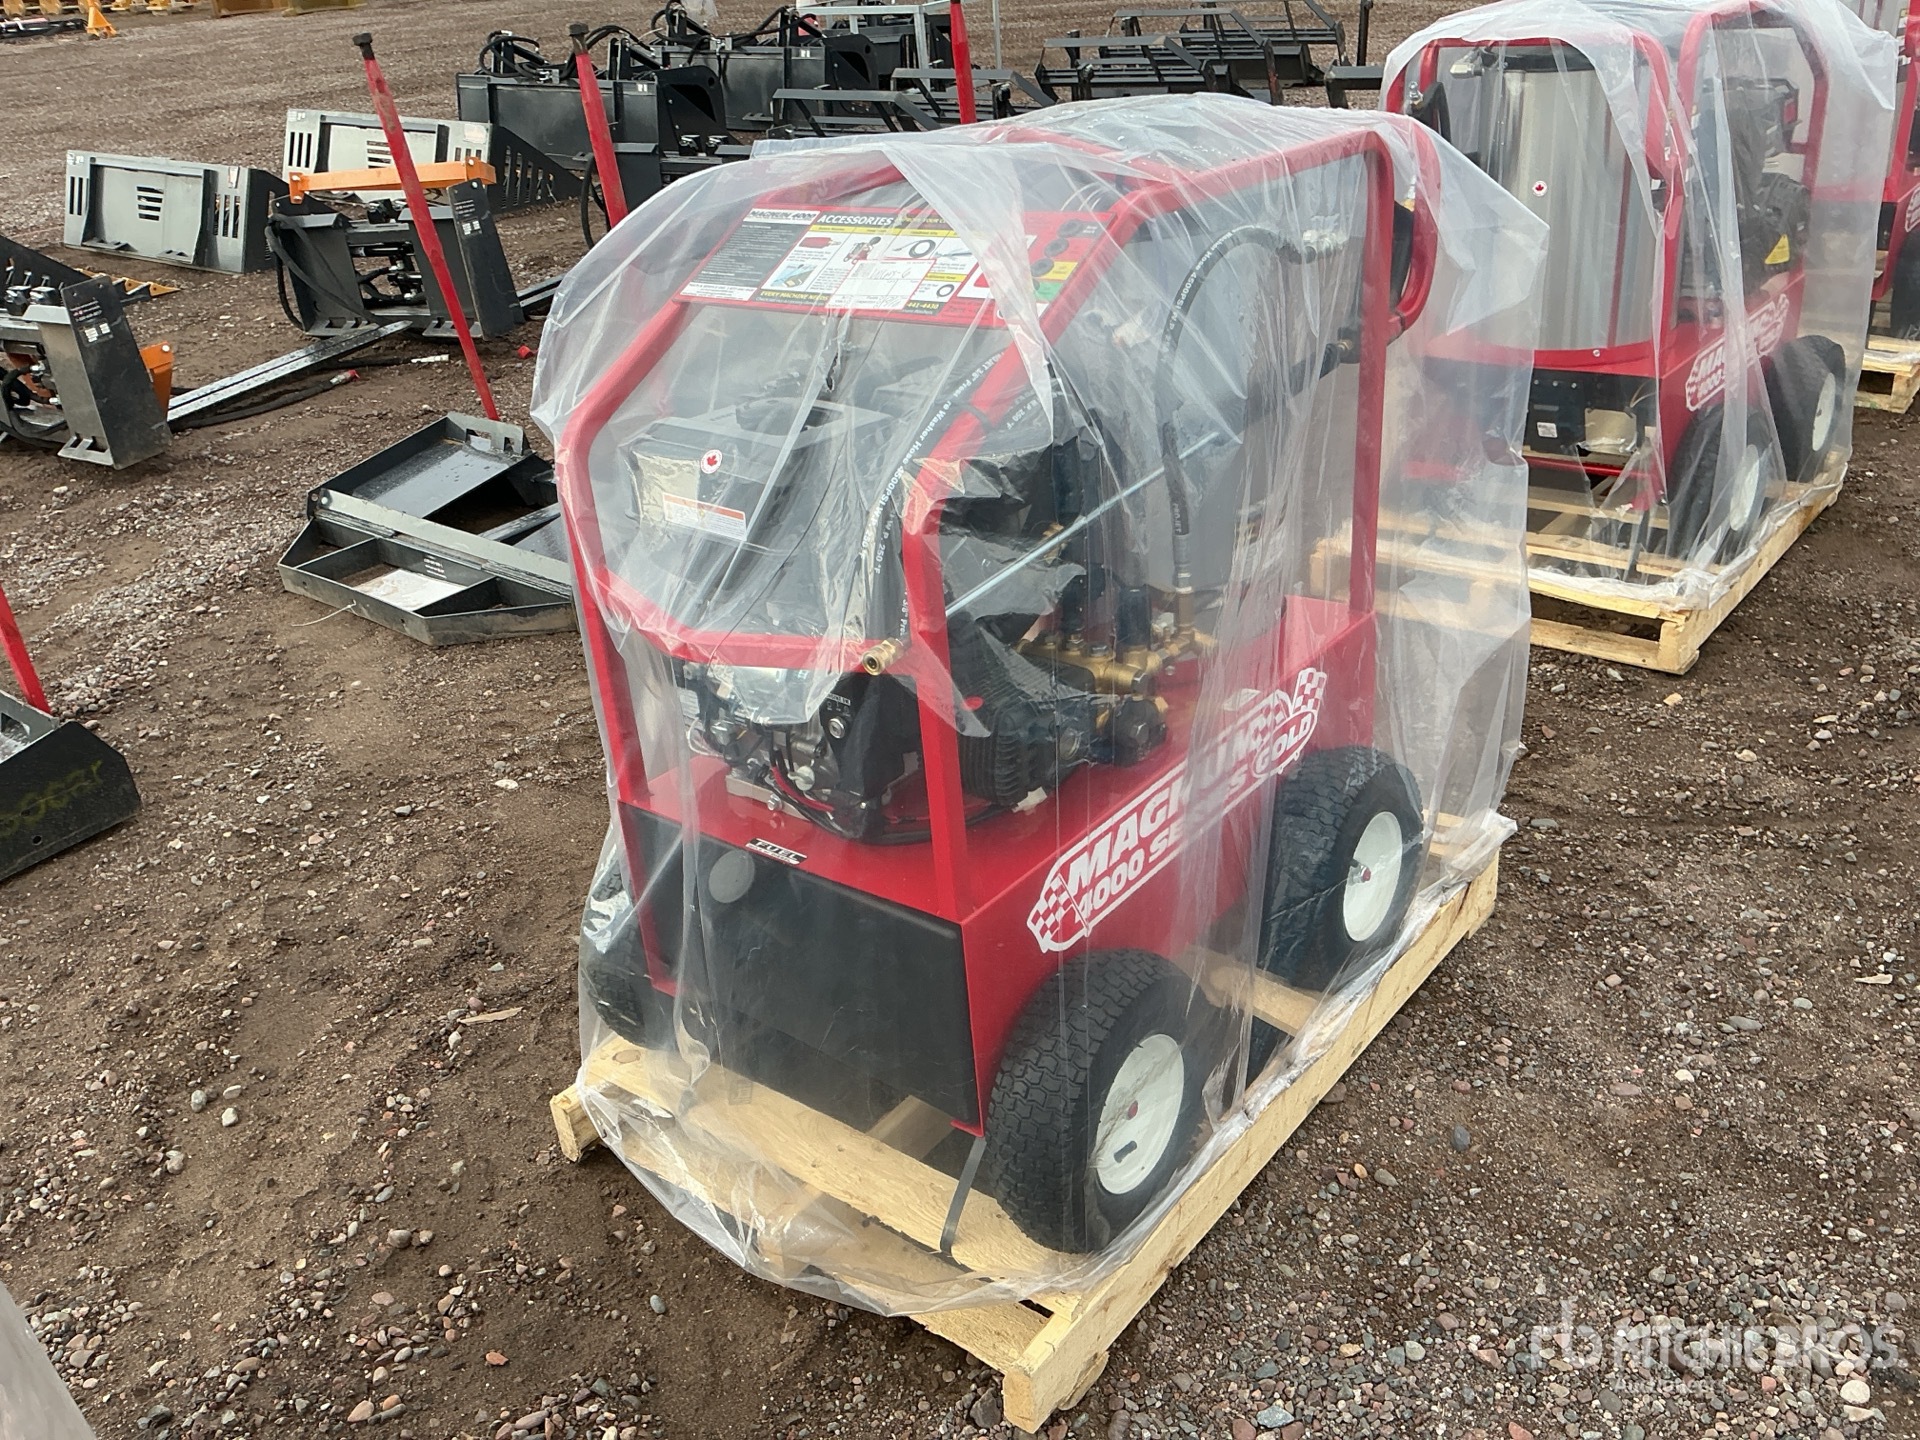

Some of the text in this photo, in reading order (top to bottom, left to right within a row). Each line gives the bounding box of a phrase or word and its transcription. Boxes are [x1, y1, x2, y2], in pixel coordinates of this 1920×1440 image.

[817, 214, 894, 226] ACCESSORIES
[1195, 250, 1213, 270] Hose
[1176, 271, 1197, 309] 4500PSI
[920, 410, 946, 441] Washer
[1012, 409, 1026, 422] 250
[902, 441, 922, 465] Hose
[880, 465, 905, 506] 4500PSI
[875, 543, 886, 562] 250
[1254, 712, 1314, 770] GOLD
[755, 840, 798, 861] FUEL
[1074, 848, 1145, 923] 4000
